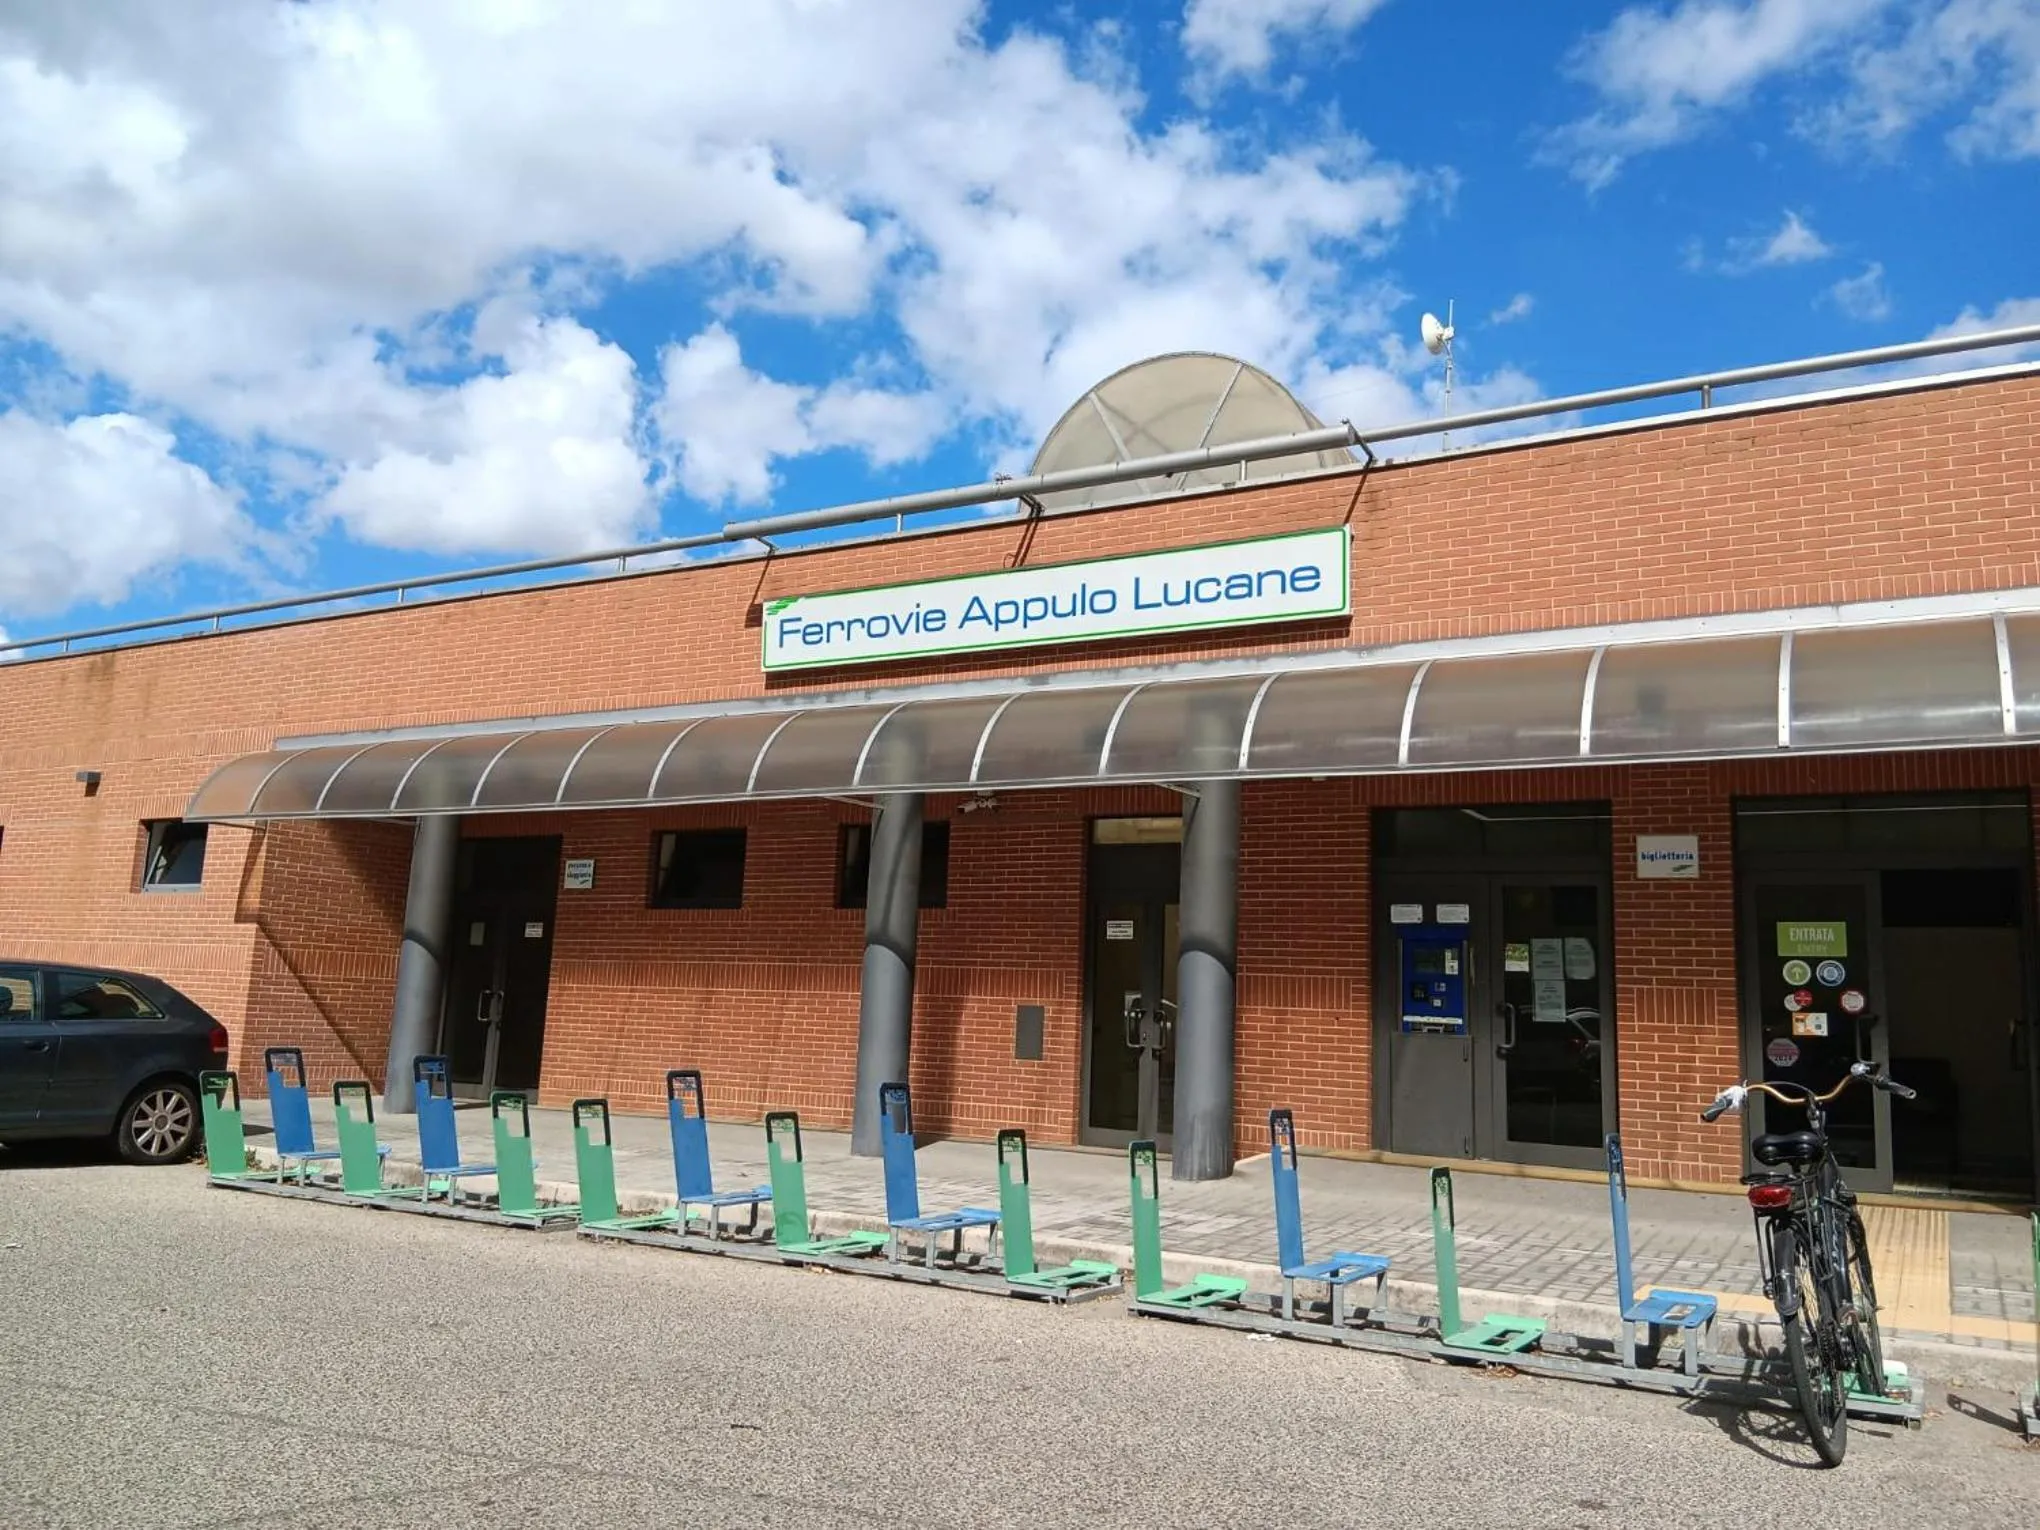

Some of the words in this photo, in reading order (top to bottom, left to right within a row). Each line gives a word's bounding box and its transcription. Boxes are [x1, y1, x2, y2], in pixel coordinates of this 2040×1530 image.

[779, 603, 946, 648] Ferrovie
[958, 583, 1117, 632] Appulo
[1133, 564, 1322, 611] Lucane
[1641, 851, 1695, 862] biglietteria
[1789, 927, 1835, 942] ENTRATA
